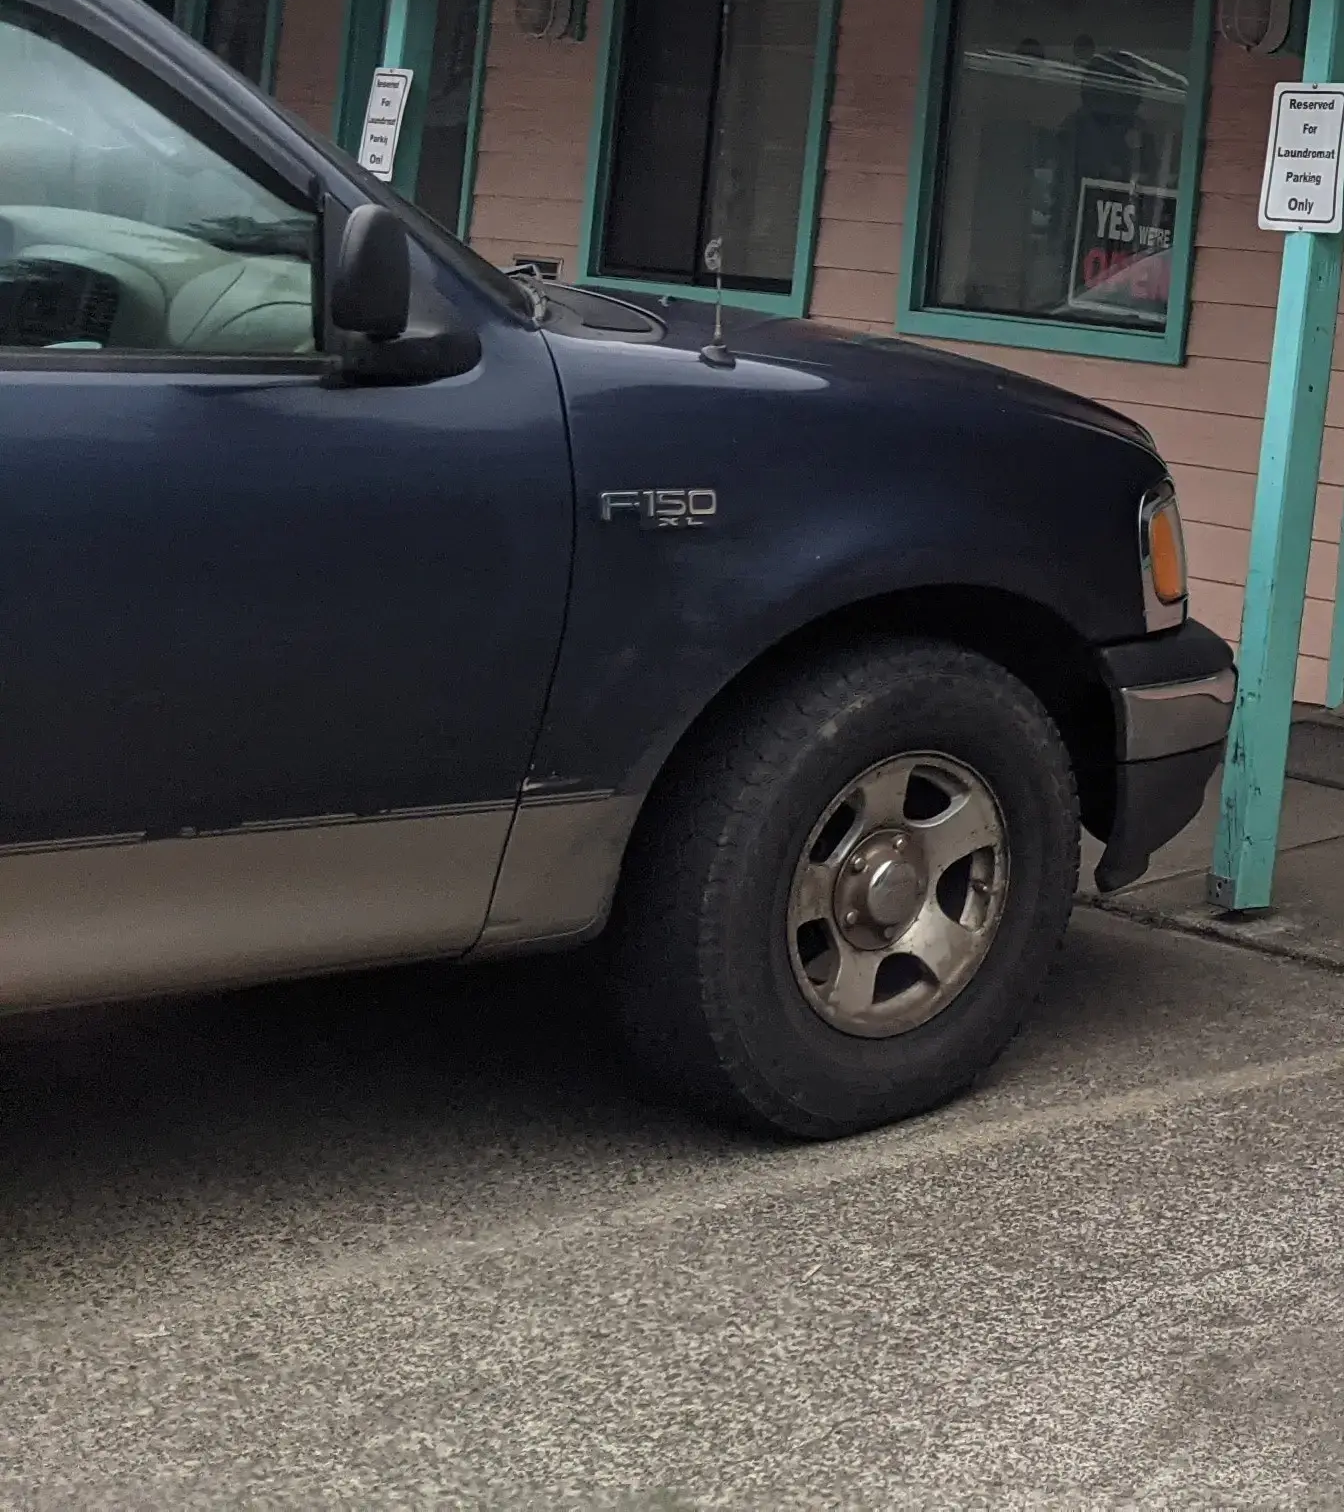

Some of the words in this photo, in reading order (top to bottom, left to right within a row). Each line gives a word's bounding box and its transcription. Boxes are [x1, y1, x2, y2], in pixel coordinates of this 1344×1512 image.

[1289, 98, 1335, 111] Reserved
[1302, 122, 1318, 135] For
[1277, 146, 1335, 160] Laundromat
[1285, 171, 1322, 186] Parking
[1287, 197, 1314, 215] Only
[1096, 199, 1136, 242] YES
[658, 516, 705, 527] XL
